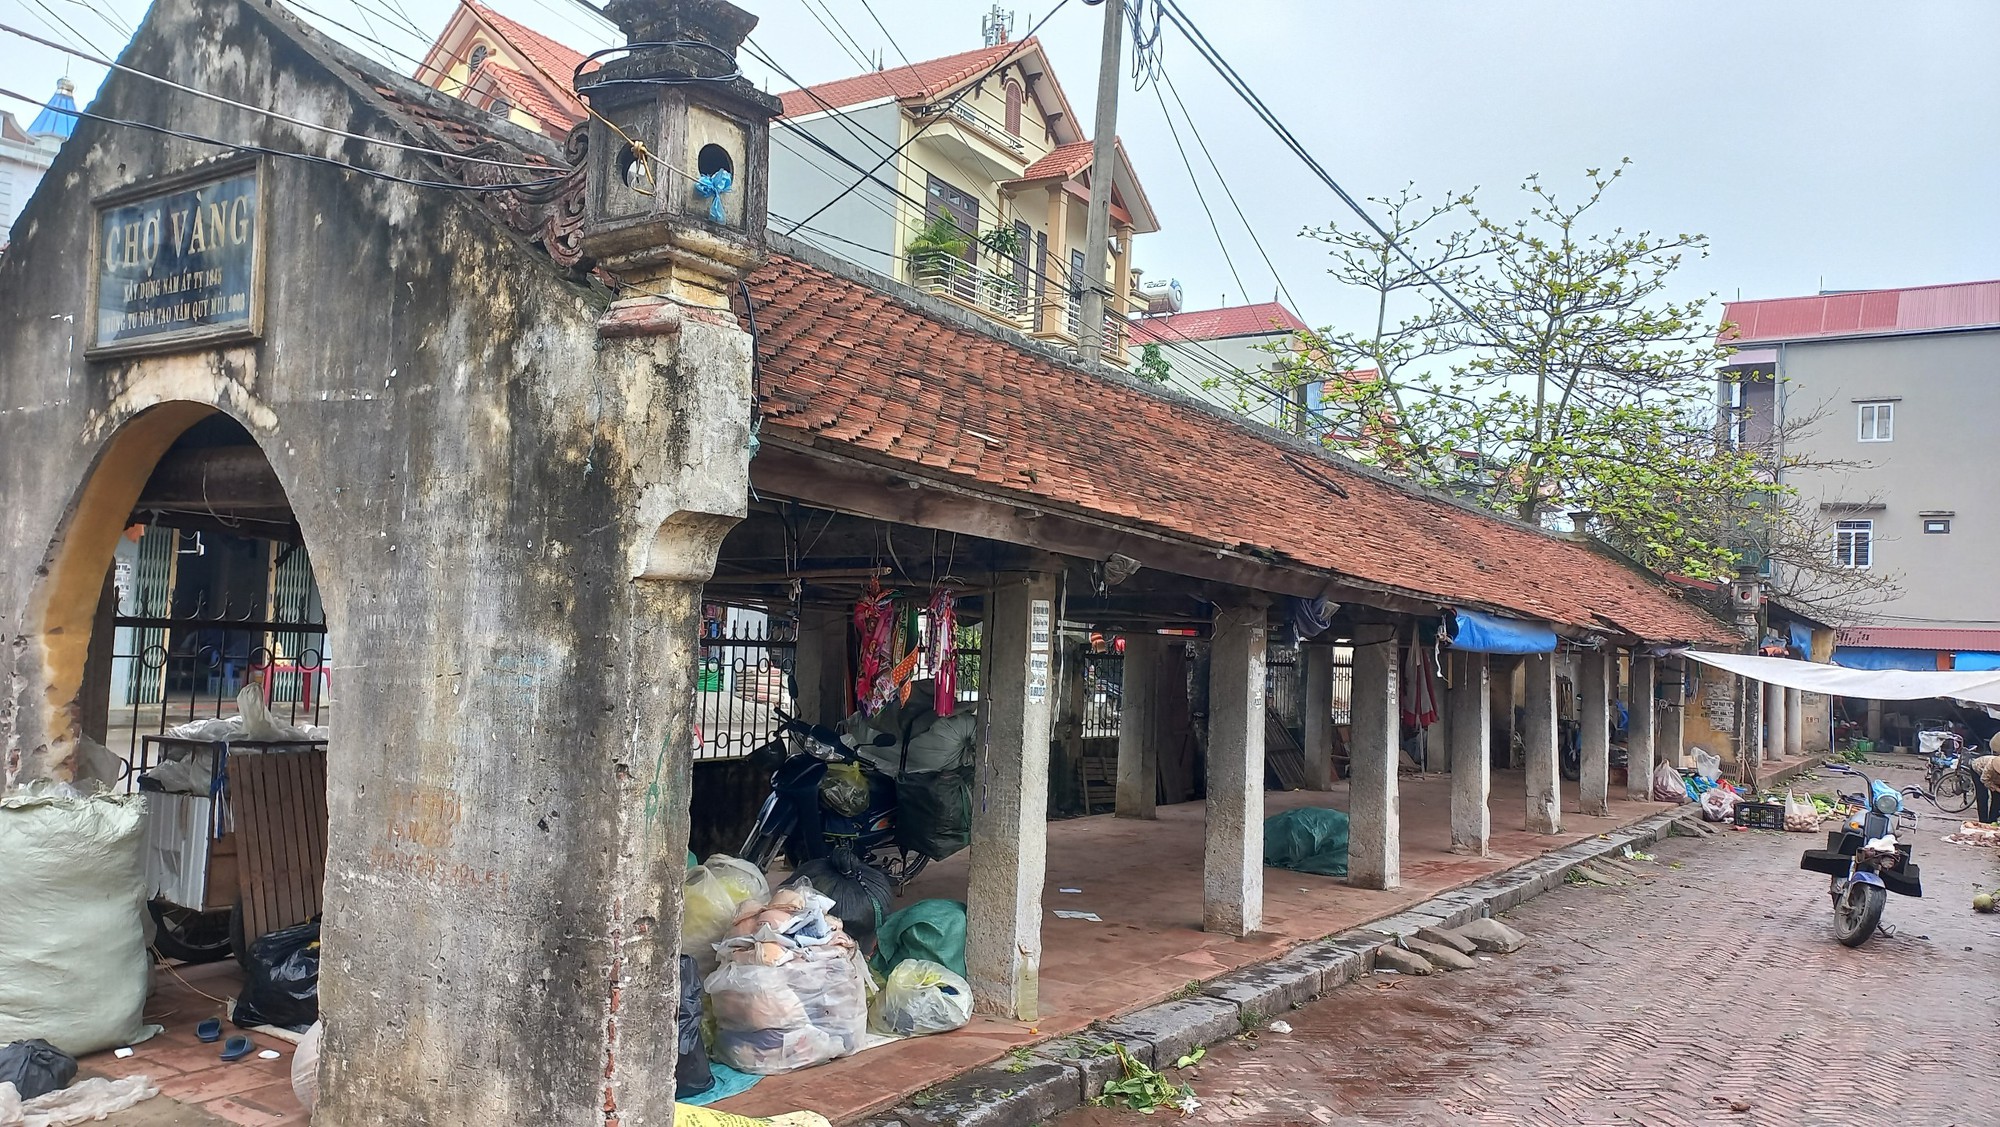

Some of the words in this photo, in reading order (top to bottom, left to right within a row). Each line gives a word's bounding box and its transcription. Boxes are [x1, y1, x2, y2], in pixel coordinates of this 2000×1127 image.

[106, 208, 160, 277] CHỢ
[171, 190, 249, 258] VÀNG
[128, 312, 138, 330] TU
